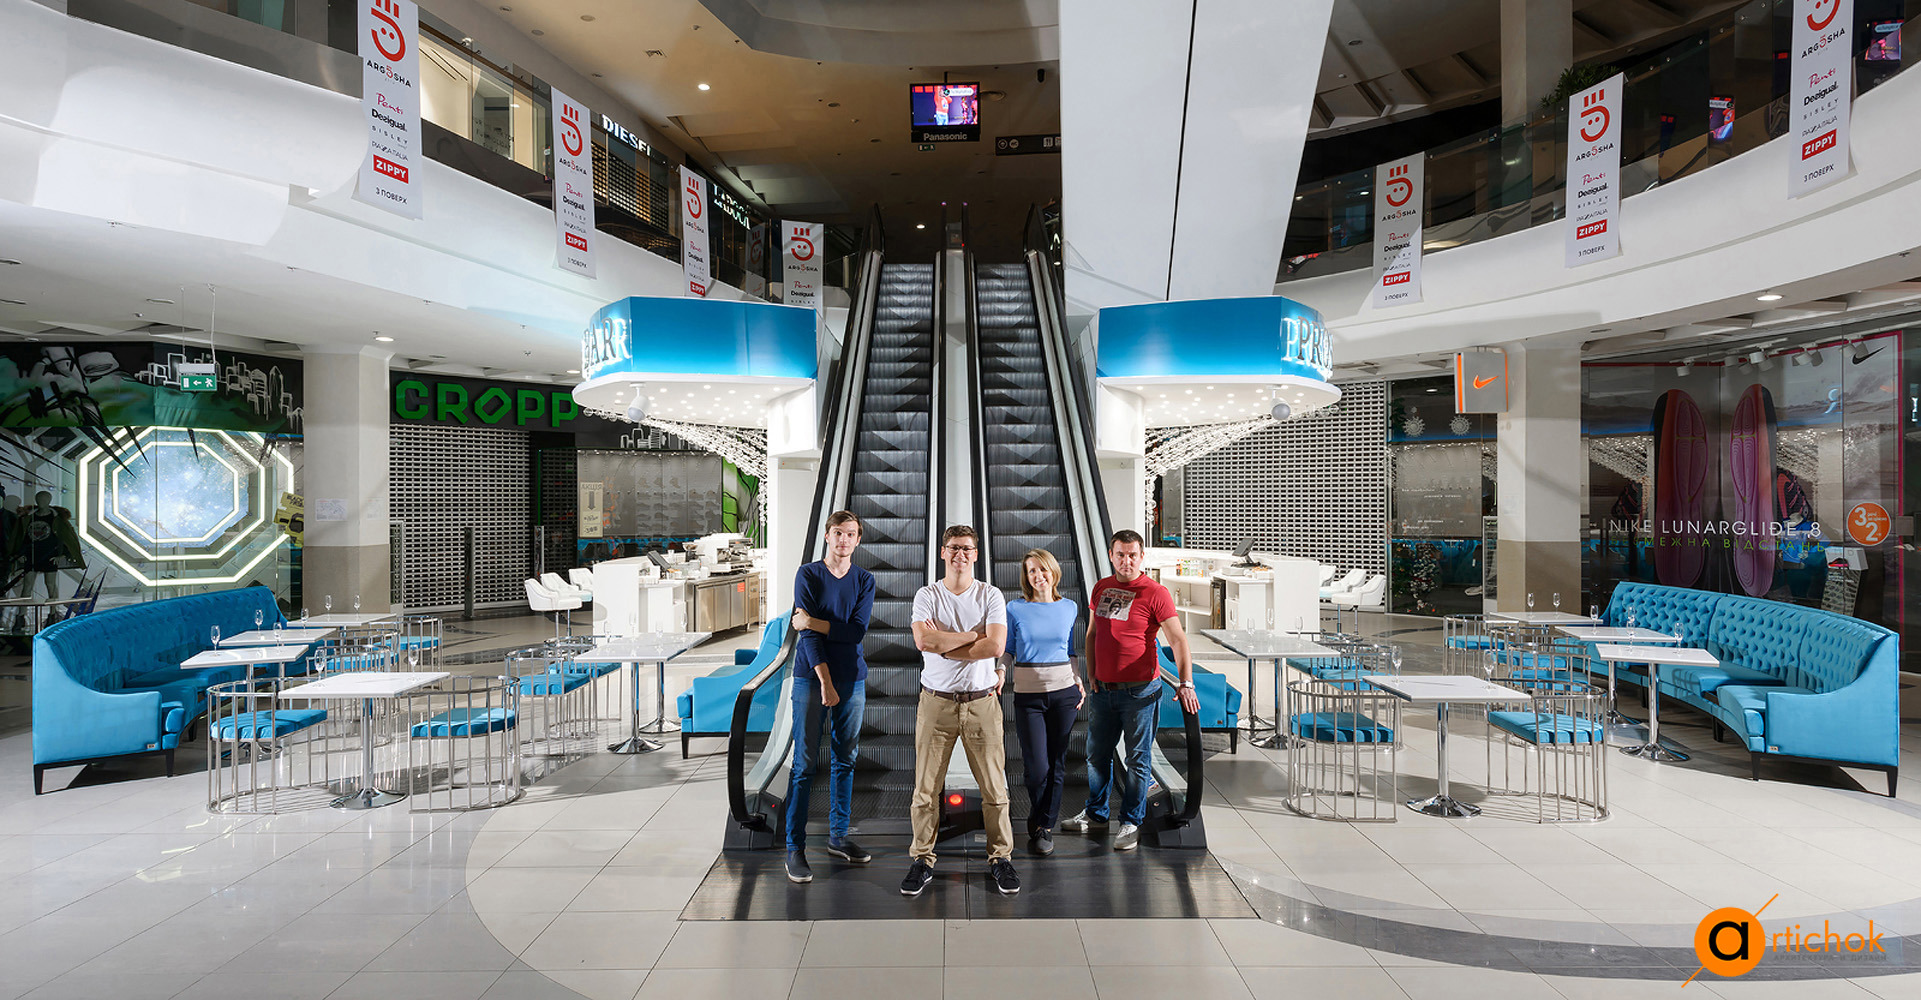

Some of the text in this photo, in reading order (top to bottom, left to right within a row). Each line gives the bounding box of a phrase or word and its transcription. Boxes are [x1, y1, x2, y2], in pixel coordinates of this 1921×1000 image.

[376, 92, 403, 115] Penti
[923, 132, 968, 141] Panasonic
[1804, 134, 1834, 156] ZIPPY
[376, 159, 407, 179] ZIPPY
[1808, 163, 1834, 180] ПОВЕРХ
[381, 189, 408, 205] ПОВЕРХ
[1579, 222, 1605, 236] ZIPPY
[567, 234, 586, 248] ZIPPY
[1582, 244, 1605, 255] ПОВЕРХ
[1385, 273, 1408, 284] ZIPPY
[395, 379, 578, 427] CROPP
[1854, 507, 1867, 526] 3
[1609, 520, 1821, 538] NIKE LUNARGLIDE 8
[1866, 522, 1878, 541] 2
[1723, 538, 1825, 552] ВІДСТАНЬ
